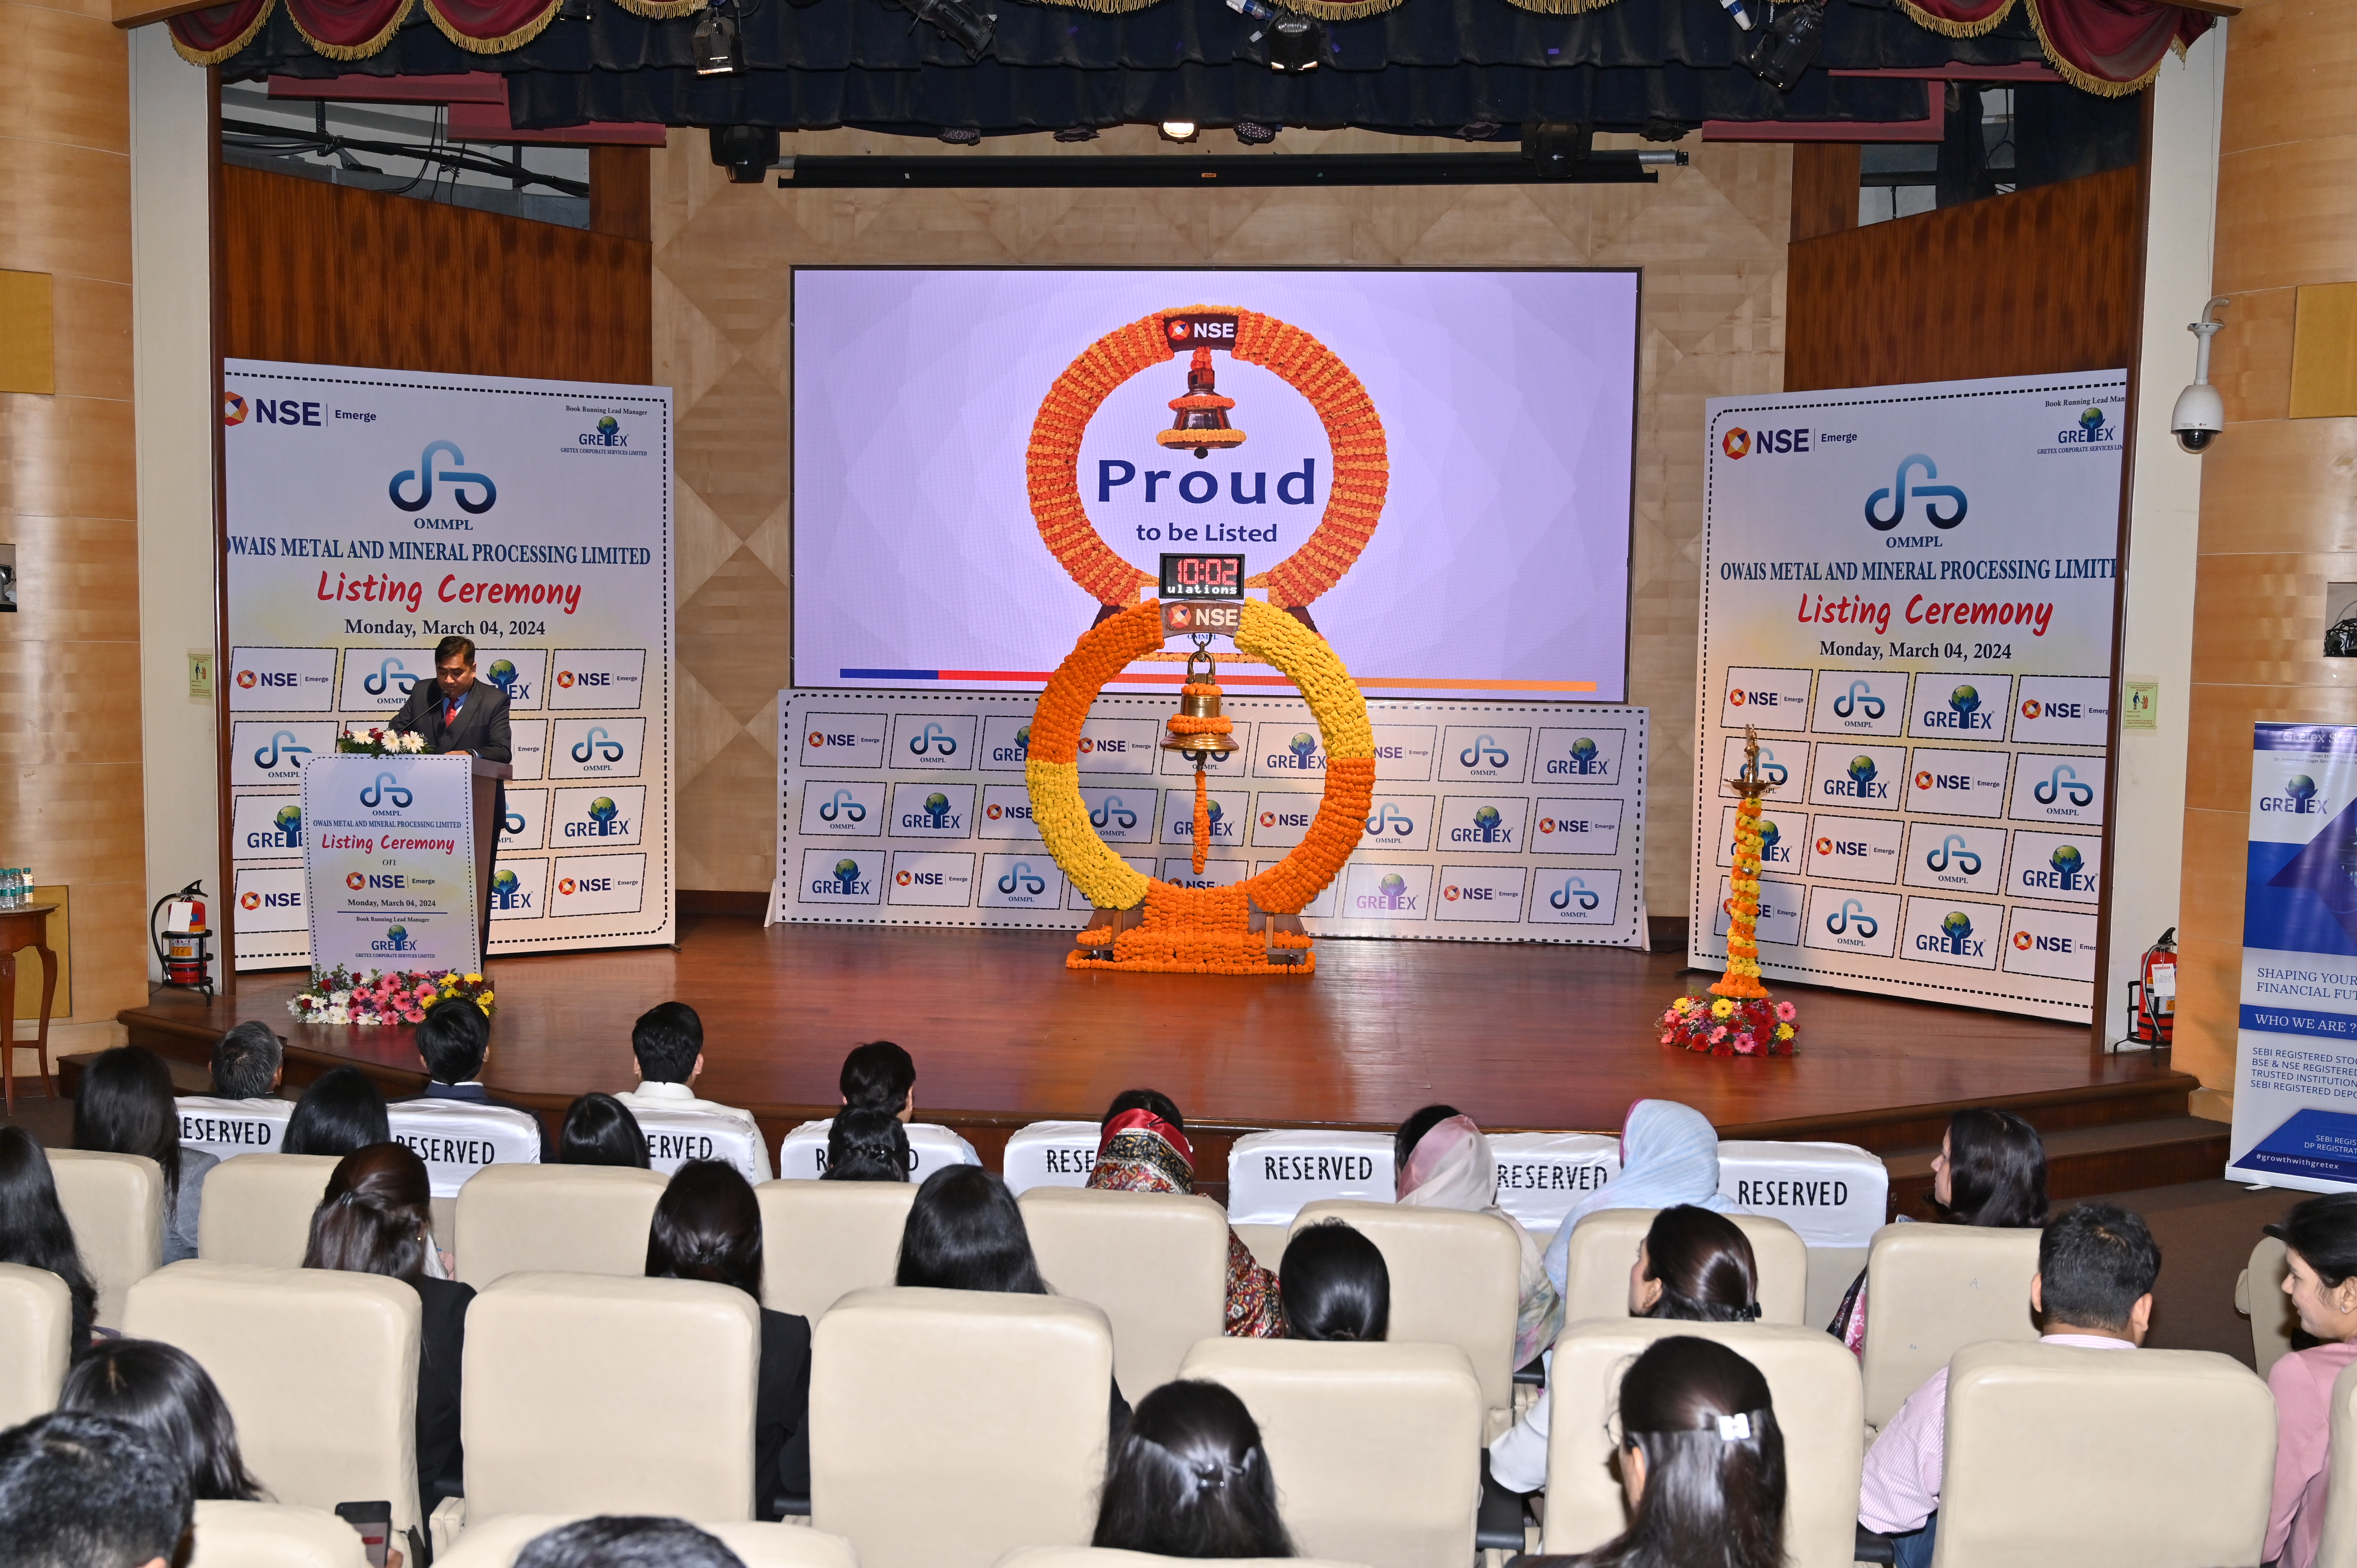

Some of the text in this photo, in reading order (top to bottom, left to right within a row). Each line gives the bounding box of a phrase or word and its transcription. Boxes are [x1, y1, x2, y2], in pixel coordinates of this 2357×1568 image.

[1194, 323, 1234, 338] NSE
[256, 399, 376, 427] NSE Emerge
[579, 434, 627, 447] GRETEX
[1756, 429, 1857, 454] NSE Emerge
[2058, 428, 2113, 443] GRETEX
[1099, 458, 1315, 505] Proud
[414, 518, 473, 530] OMMPL
[1136, 523, 1277, 542] to be Listed
[1886, 536, 1942, 548] OMMPL
[281, 538, 650, 565] METAL AND MINERAL PROCESSING LIMITED
[1178, 559, 1238, 585] 10:02
[1721, 558, 2051, 581] OWAIS METAL AND MINERAL PROCESSING
[318, 570, 581, 614] Listing Ceremony
[1168, 584, 1237, 594] ulations
[1196, 609, 1238, 626] NSE
[1798, 593, 2053, 636] Listing Ceremony
[345, 619, 545, 637] Monday, March 04, 2024
[1820, 641, 2012, 660] Monday, March 04, 2024
[261, 673, 297, 686] NSE
[579, 673, 610, 685] NSE
[1749, 692, 1777, 705] NSE
[2045, 703, 2081, 718] NSE
[1924, 711, 1991, 729] GRETEX
[827, 735, 855, 746] NSE
[1097, 740, 1125, 752] NSE
[1824, 780, 1887, 798] GRETEX
[1937, 775, 1970, 790] NSE
[2260, 797, 2327, 814] GRETEX
[1279, 814, 1308, 826] NSE
[1559, 820, 1588, 832] NSE
[564, 821, 629, 837] GRETEX
[1451, 828, 1511, 843] GRETEX
[322, 834, 454, 855] Listing Ceremony
[1836, 841, 1867, 856] NSE
[382, 858, 396, 866] on
[369, 875, 405, 888] NSE
[580, 878, 611, 892] NSE
[915, 873, 943, 885] NSE
[1938, 875, 1968, 884] OMMPL
[2023, 870, 2096, 892] GRETEX
[812, 880, 870, 895] GRETEX
[1463, 888, 1493, 900] NSE
[265, 893, 300, 907] NSE
[348, 899, 378, 908] Monday,
[371, 941, 416, 951] GRETEX
[1838, 938, 1866, 946] OMMPL
[1916, 934, 1984, 957] GRETEX
[2036, 936, 2072, 953] NSE
[2257, 968, 2357, 985] SHAPING YOUR
[2256, 982, 2330, 997] FINANCIAL
[2255, 1014, 2356, 1033] WHO WE ARE ?
[2253, 1047, 2333, 1062] SEBI REGISTERED
[2252, 1058, 2269, 1067] BSE
[2282, 1061, 2300, 1070] NSE
[2251, 1069, 2293, 1080] TRUSTED
[2251, 1080, 2330, 1095] SEBI REGISTERED
[2316, 1135, 2332, 1143] SEBI
[1265, 1157, 1372, 1180] RESERVED
[2256, 1153, 2338, 1169] #growthwithgretex
[1498, 1164, 1607, 1190] RESERVED
[1739, 1181, 1847, 1206] RESERVED
